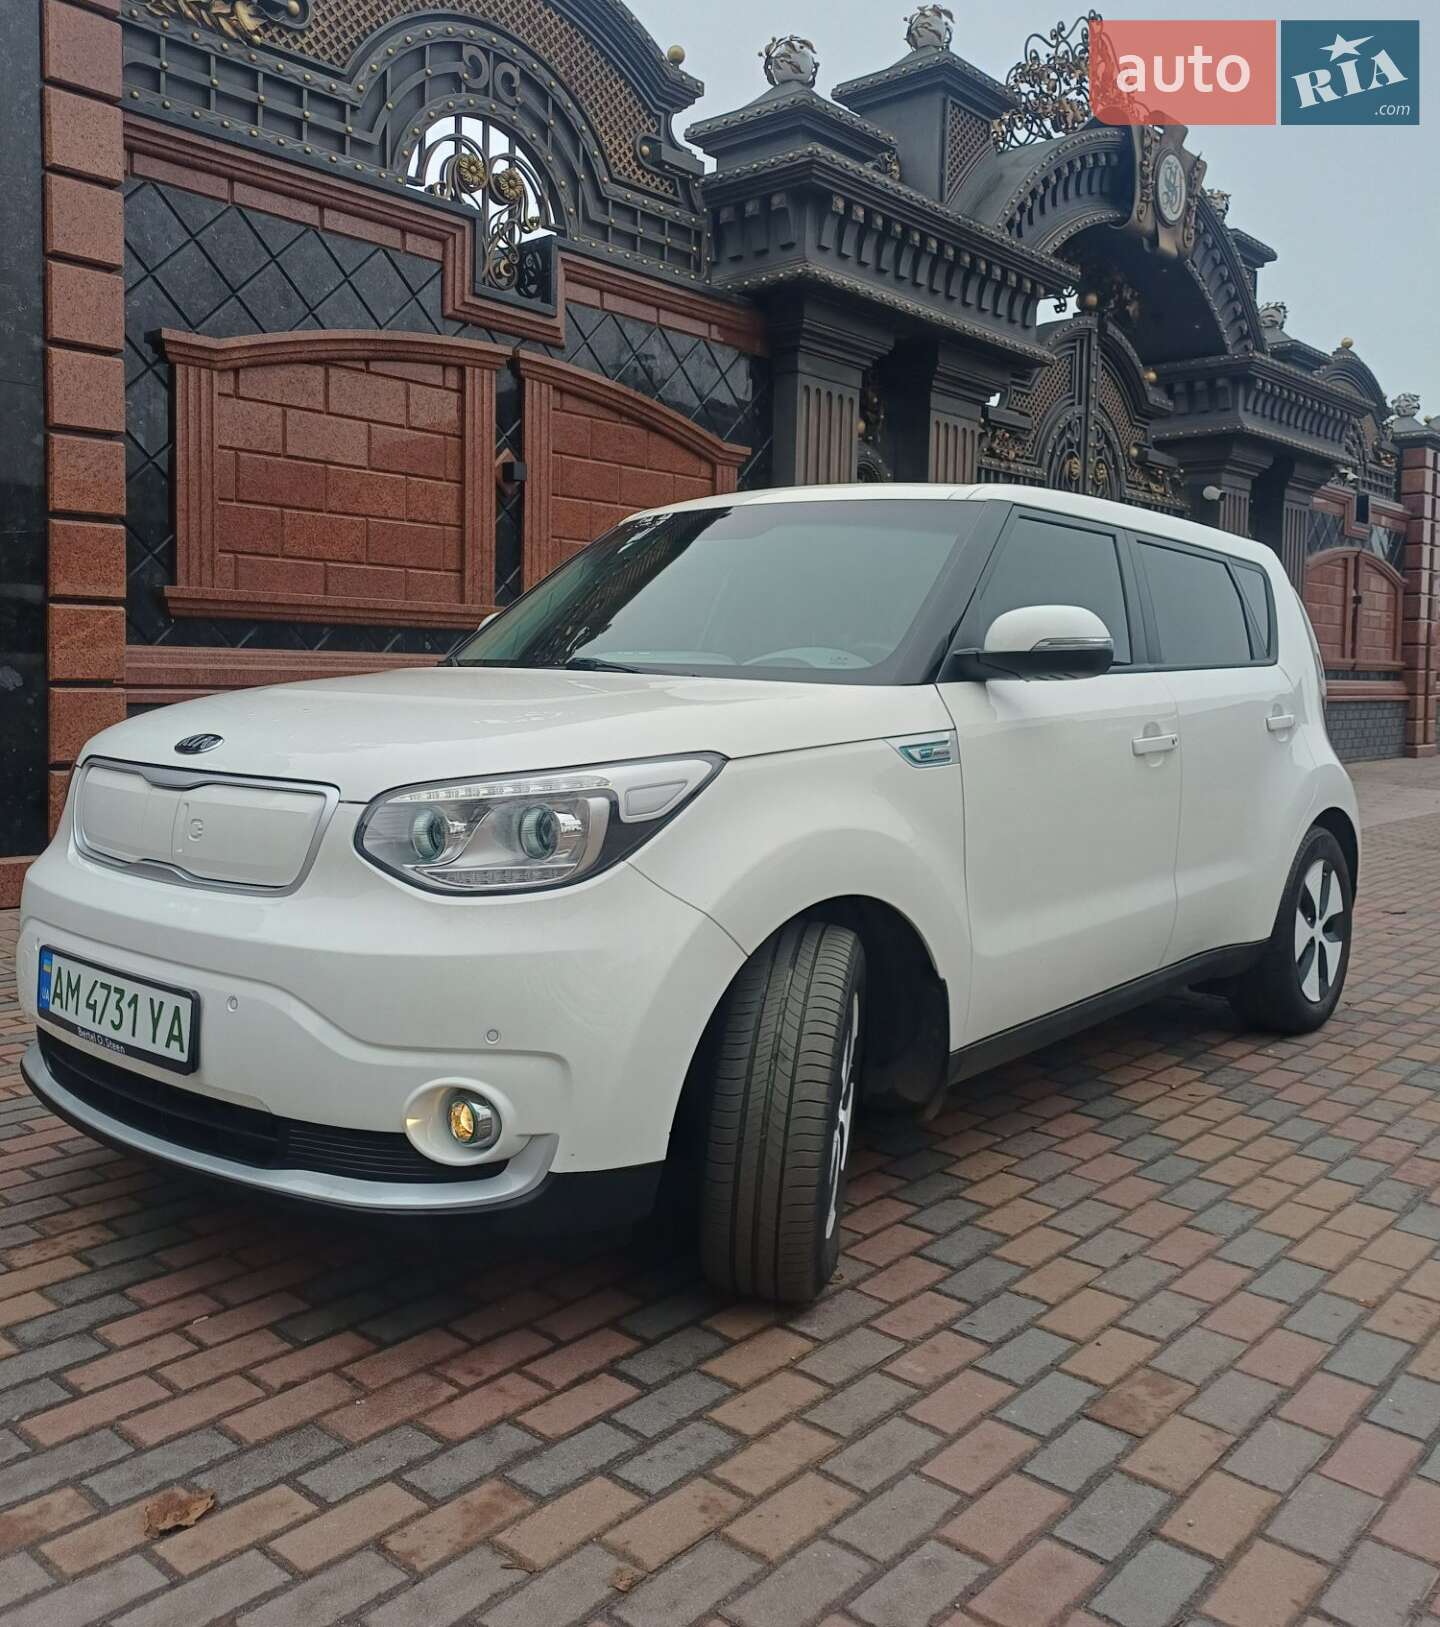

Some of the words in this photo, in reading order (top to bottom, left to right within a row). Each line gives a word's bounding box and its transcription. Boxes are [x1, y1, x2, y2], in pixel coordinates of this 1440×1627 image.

[51, 966, 81, 1016] AM
[85, 979, 139, 1038] 4731
[149, 997, 185, 1053] YA
